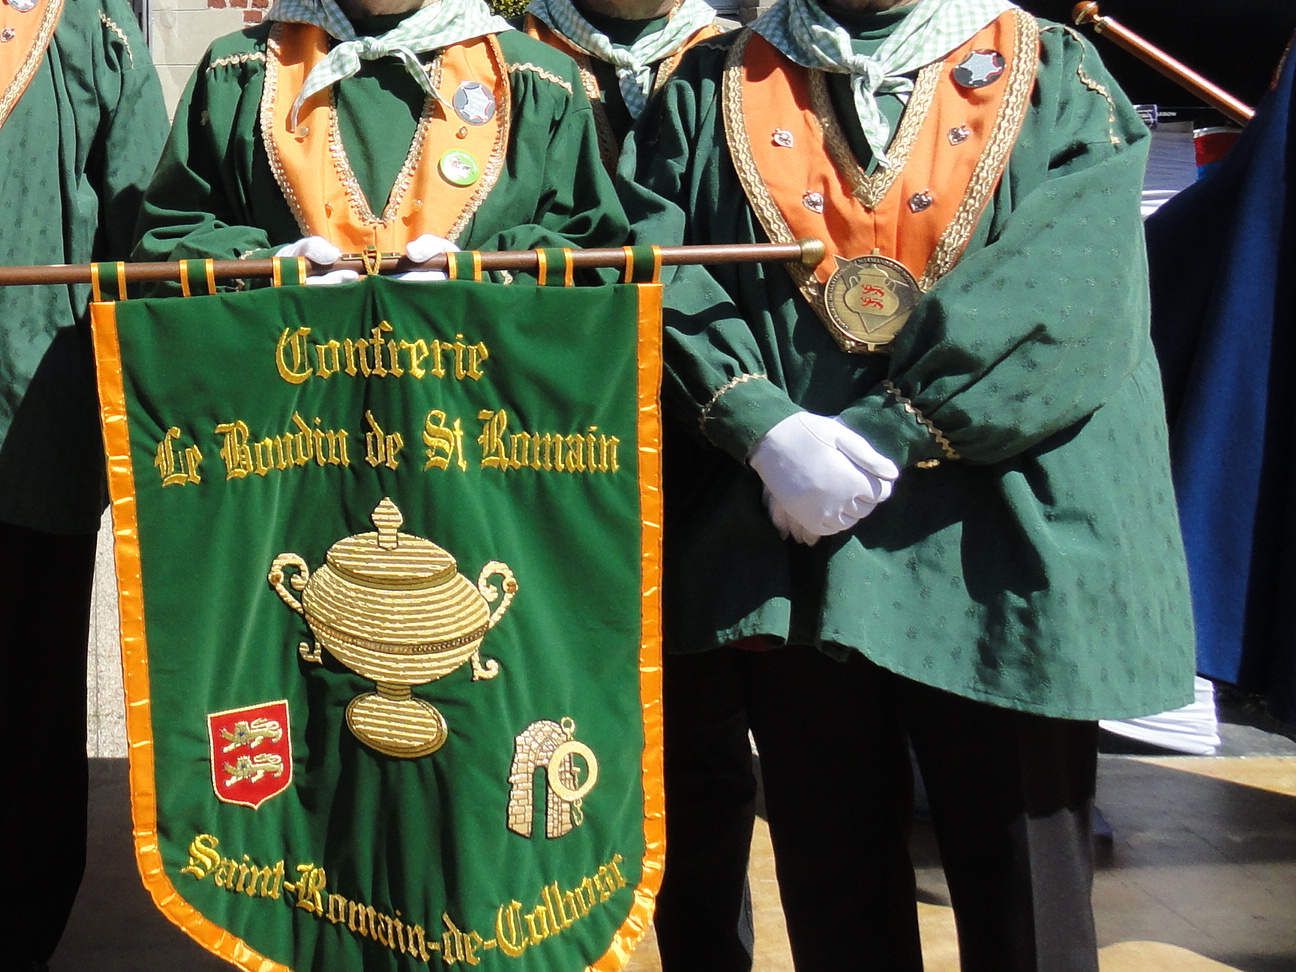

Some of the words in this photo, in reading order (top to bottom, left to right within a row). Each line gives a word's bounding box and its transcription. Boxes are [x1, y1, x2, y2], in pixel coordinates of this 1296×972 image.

[275, 320, 490, 385] Confrerie
[154, 426, 204, 488] Le
[214, 410, 352, 482] Boudin
[365, 409, 404, 471] de
[422, 409, 468, 472] St
[477, 408, 621, 474] Romain
